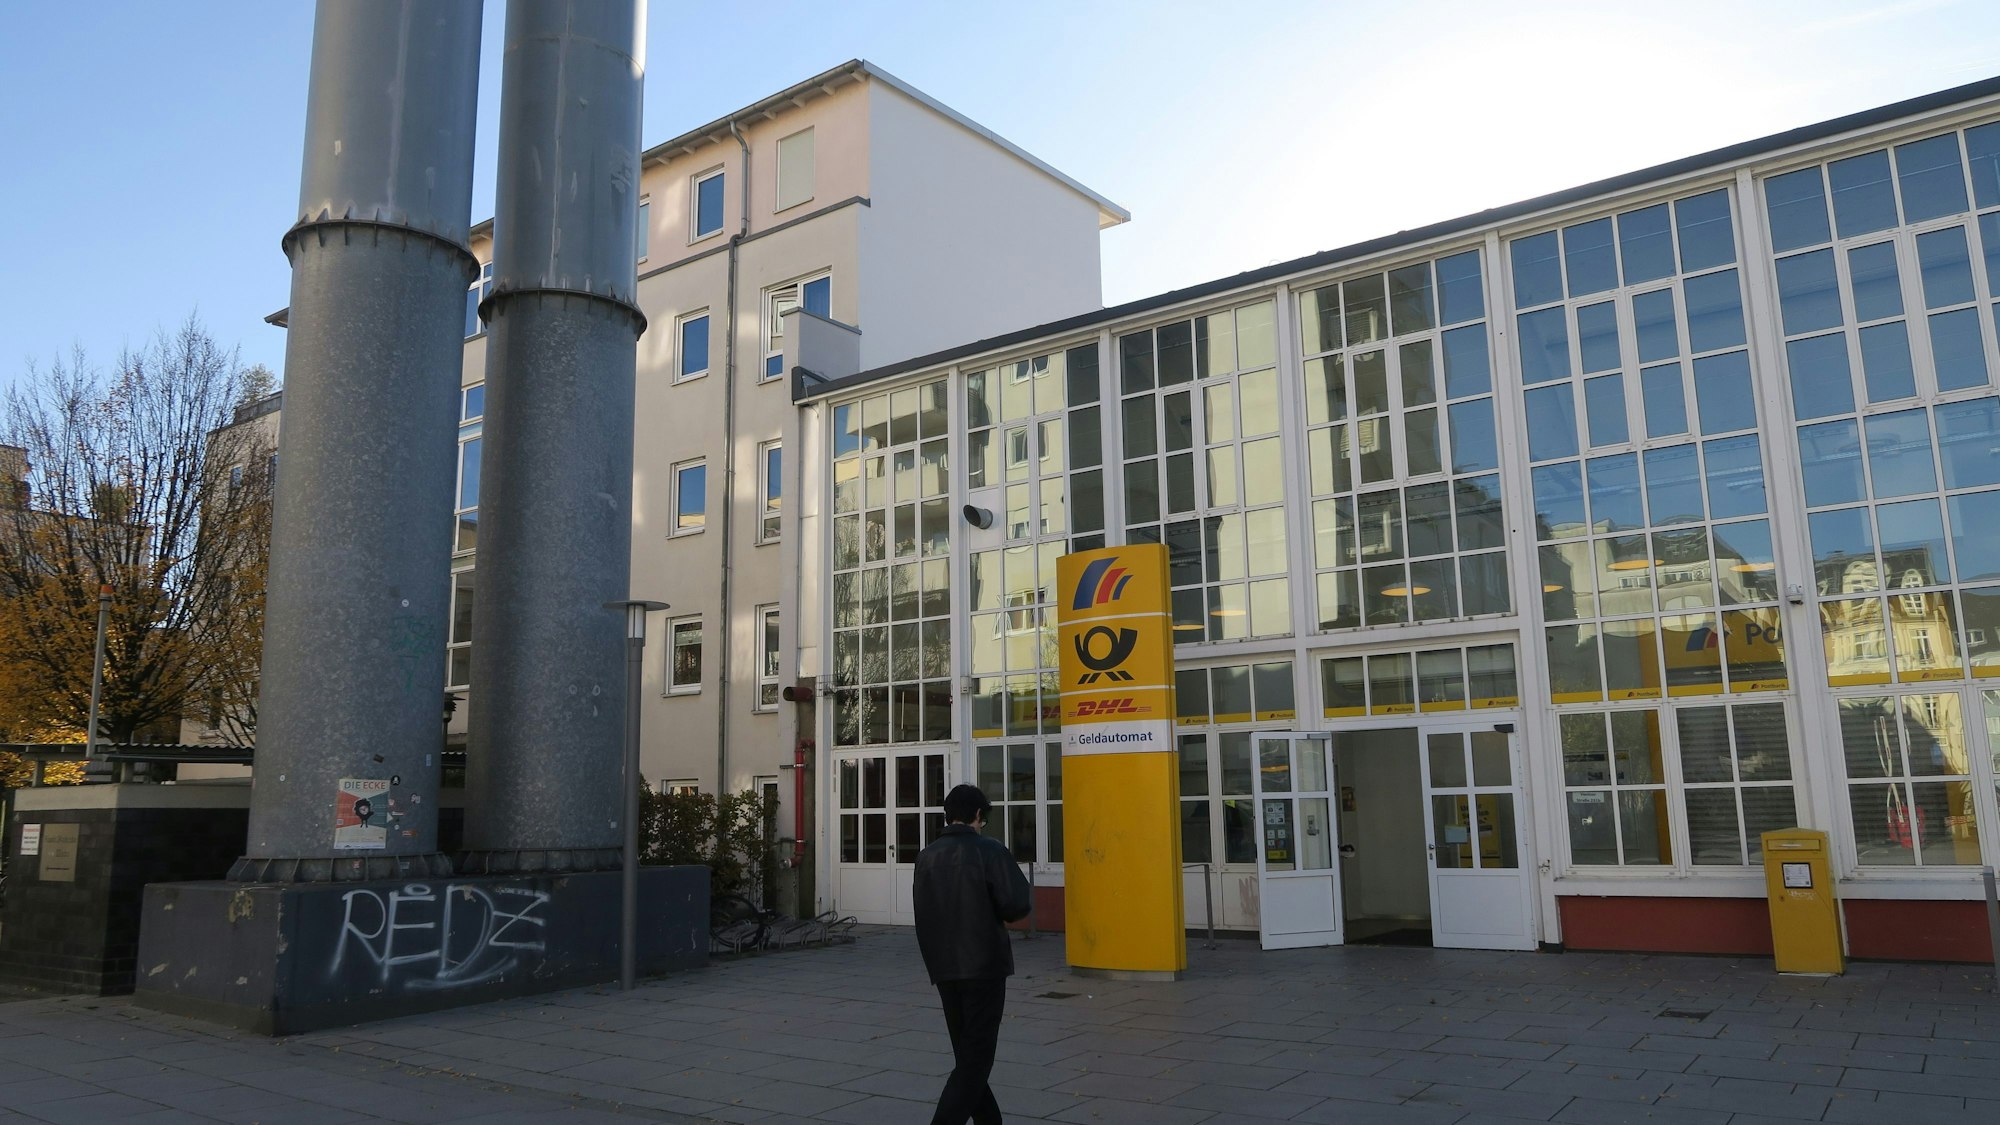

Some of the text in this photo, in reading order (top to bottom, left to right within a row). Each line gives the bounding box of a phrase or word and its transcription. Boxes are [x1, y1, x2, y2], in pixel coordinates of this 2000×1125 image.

[1076, 698, 1138, 717] DHL
[1078, 731, 1154, 745] Geldautomat
[344, 781, 386, 790] DIE ECKE
